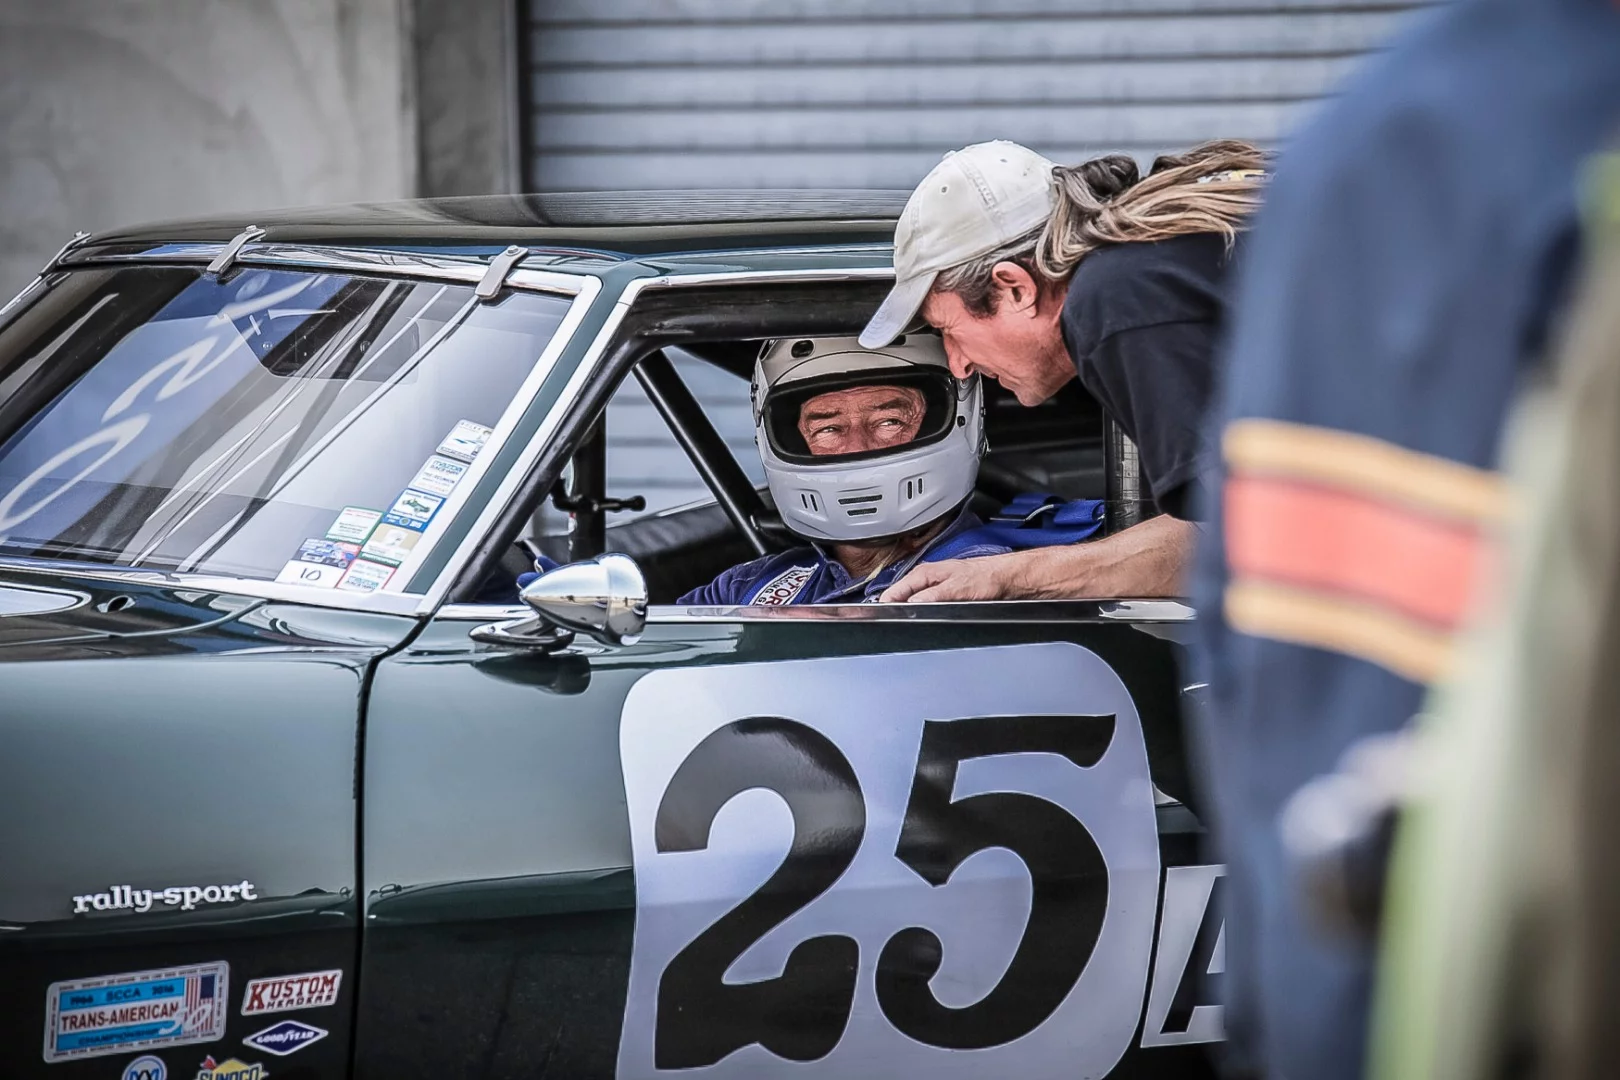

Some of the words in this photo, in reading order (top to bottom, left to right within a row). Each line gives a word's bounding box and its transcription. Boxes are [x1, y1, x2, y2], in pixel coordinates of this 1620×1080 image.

[73, 880, 257, 914] rally-sport
[654, 713, 1117, 1071] 25
[106, 987, 141, 1001] SCCA
[246, 974, 338, 1012] KUSTOM
[61, 1001, 180, 1032] TRANS-AMERICAN
